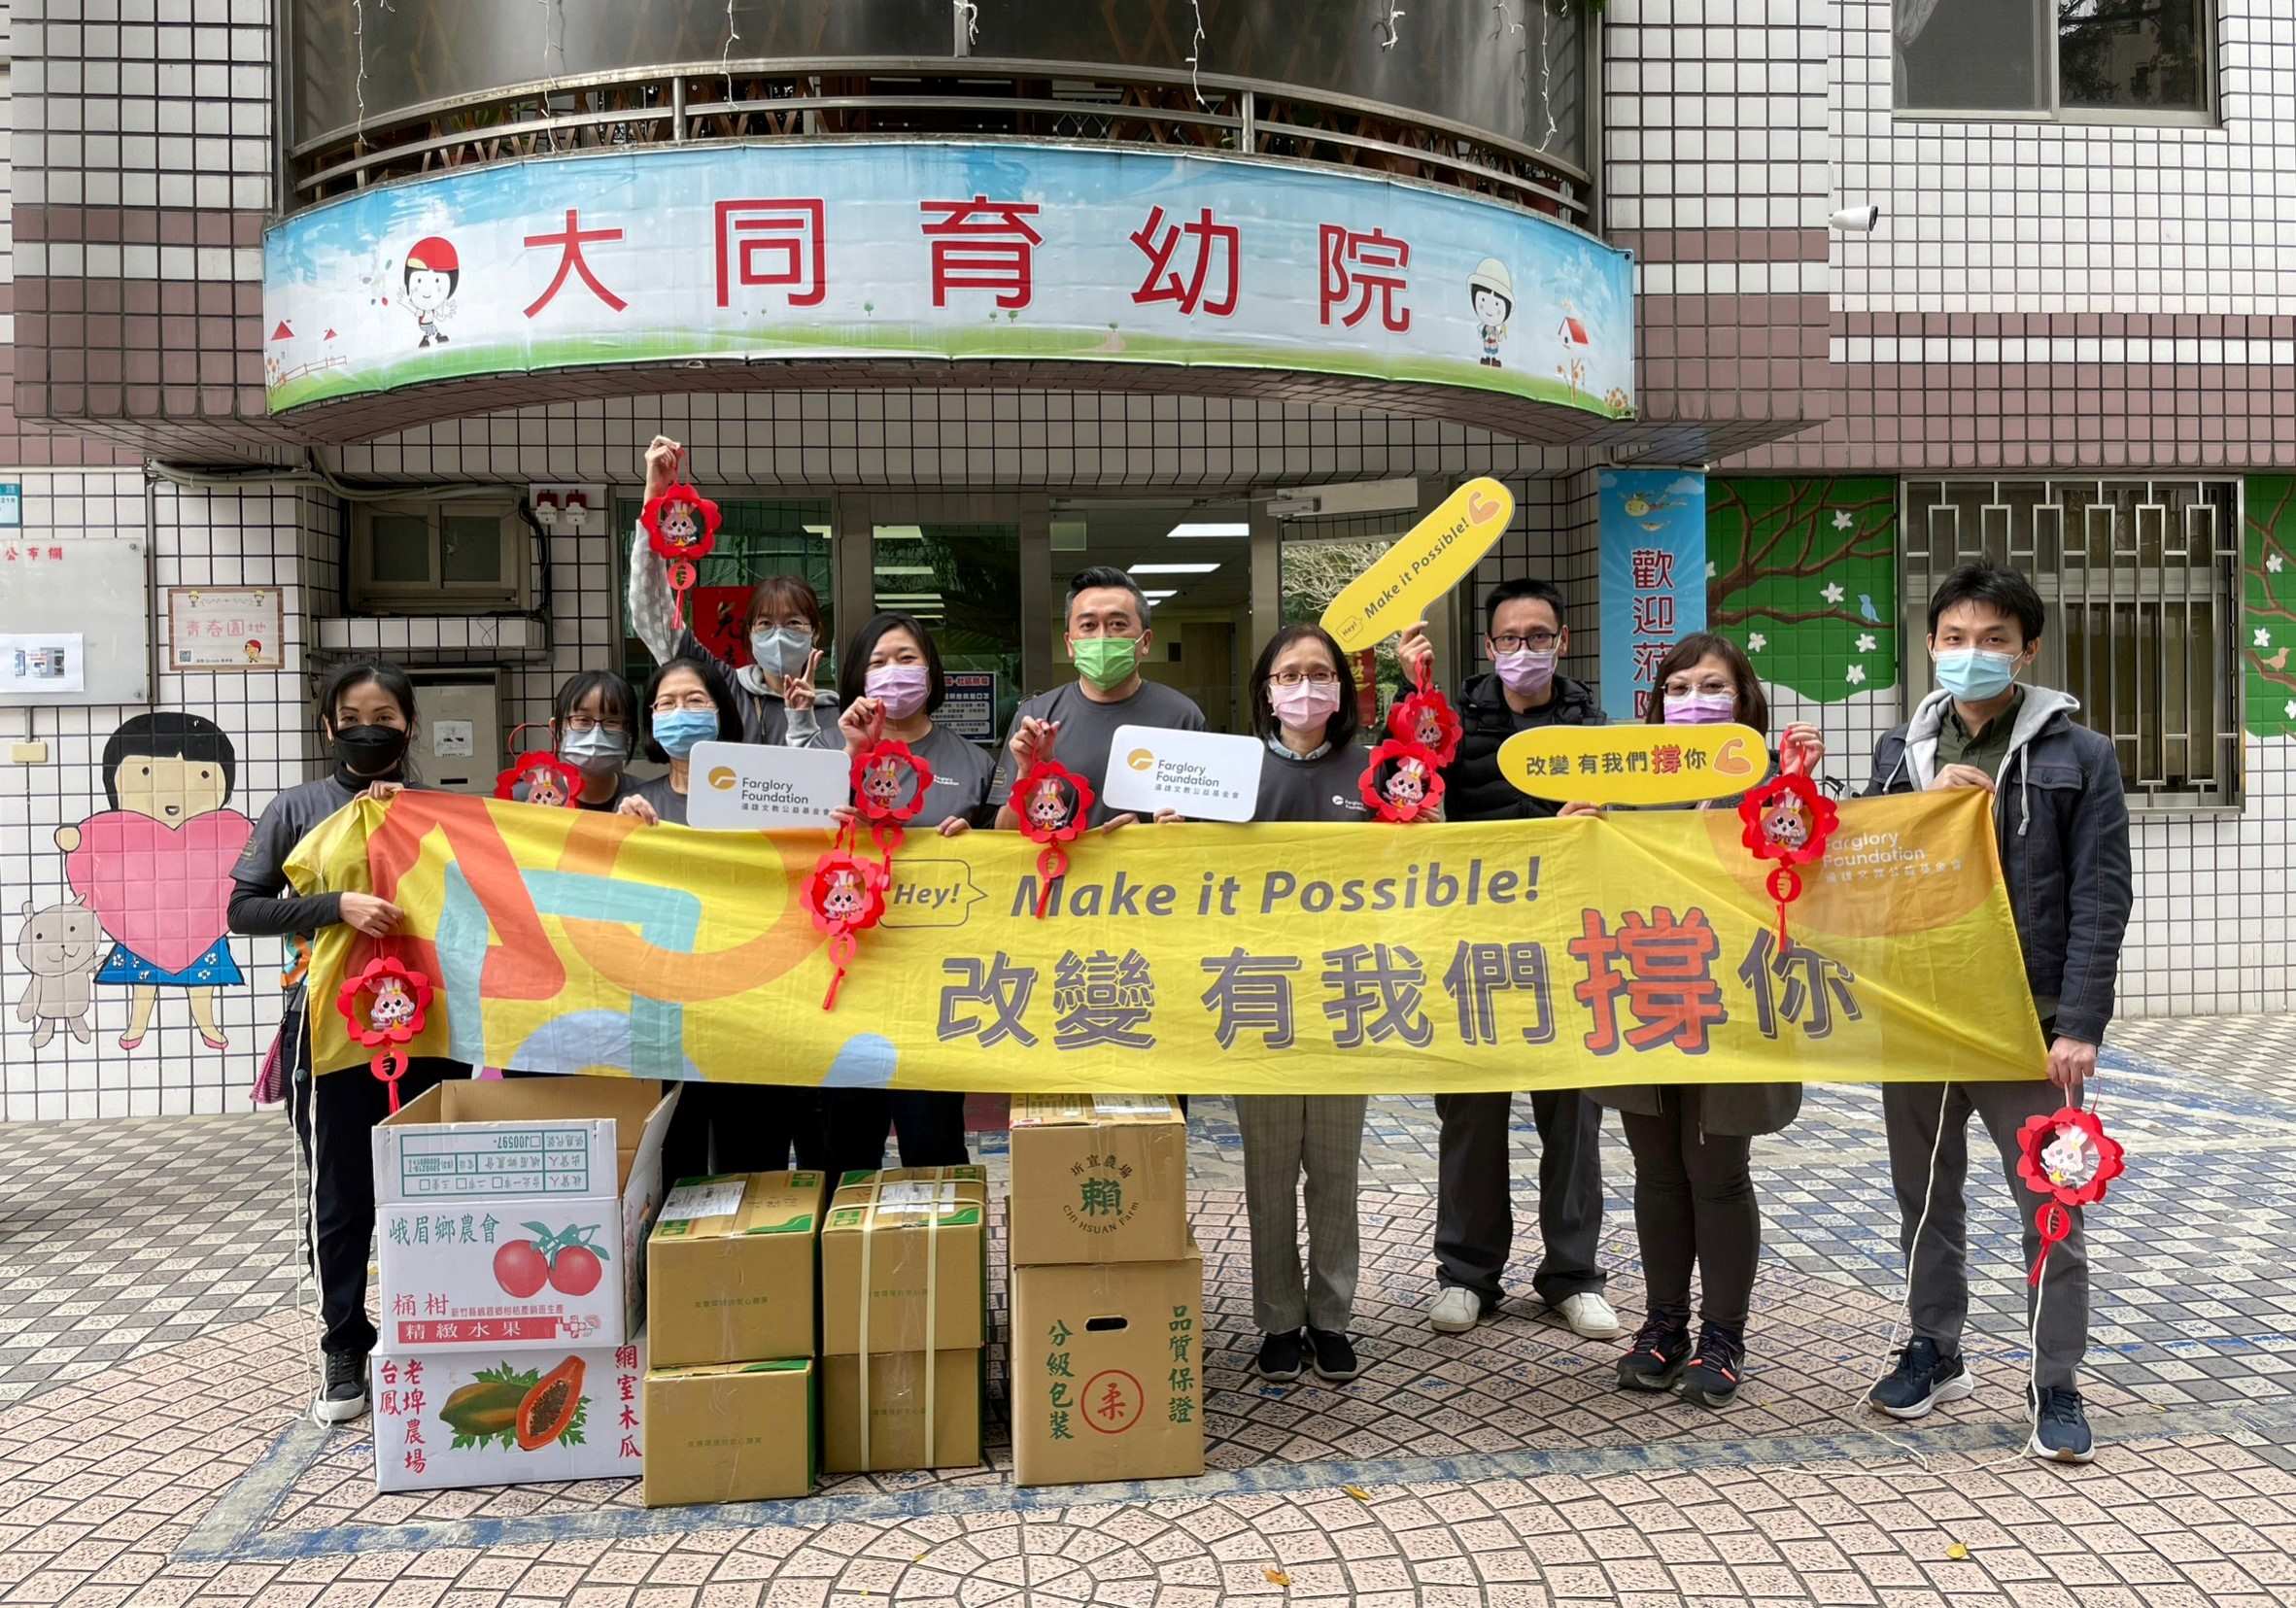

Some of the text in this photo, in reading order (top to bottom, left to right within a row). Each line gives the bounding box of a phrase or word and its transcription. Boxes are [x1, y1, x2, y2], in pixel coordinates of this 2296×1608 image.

[524, 195, 1412, 333] 大同育幼院
[1364, 585, 1400, 619] Make
[1399, 571, 1413, 587] it
[1411, 517, 1469, 574] Possible!
[1156, 771, 1219, 787] Foundation
[1157, 760, 1206, 775] Farglory
[1525, 744, 1707, 776] 改變 有我們撐你
[741, 777, 793, 793] Farglory
[741, 790, 808, 804] Foundation
[1823, 847, 1926, 868] Foundation
[893, 856, 1541, 918] Hey! Make it Possible!
[936, 947, 1157, 1050] 改變
[390, 1213, 500, 1246] 峨眉鄉農會
[1079, 1221, 1117, 1234] HSUAN
[393, 1293, 449, 1316] 桶柑
[1046, 1319, 1075, 1440] 分級包裝
[1168, 1305, 1195, 1423] 品質保證
[380, 1359, 401, 1416] 台鳳
[615, 1345, 642, 1458] 網室木瓜
[1097, 1382, 1126, 1420] 柔
[403, 1358, 427, 1474] 老埤農場
